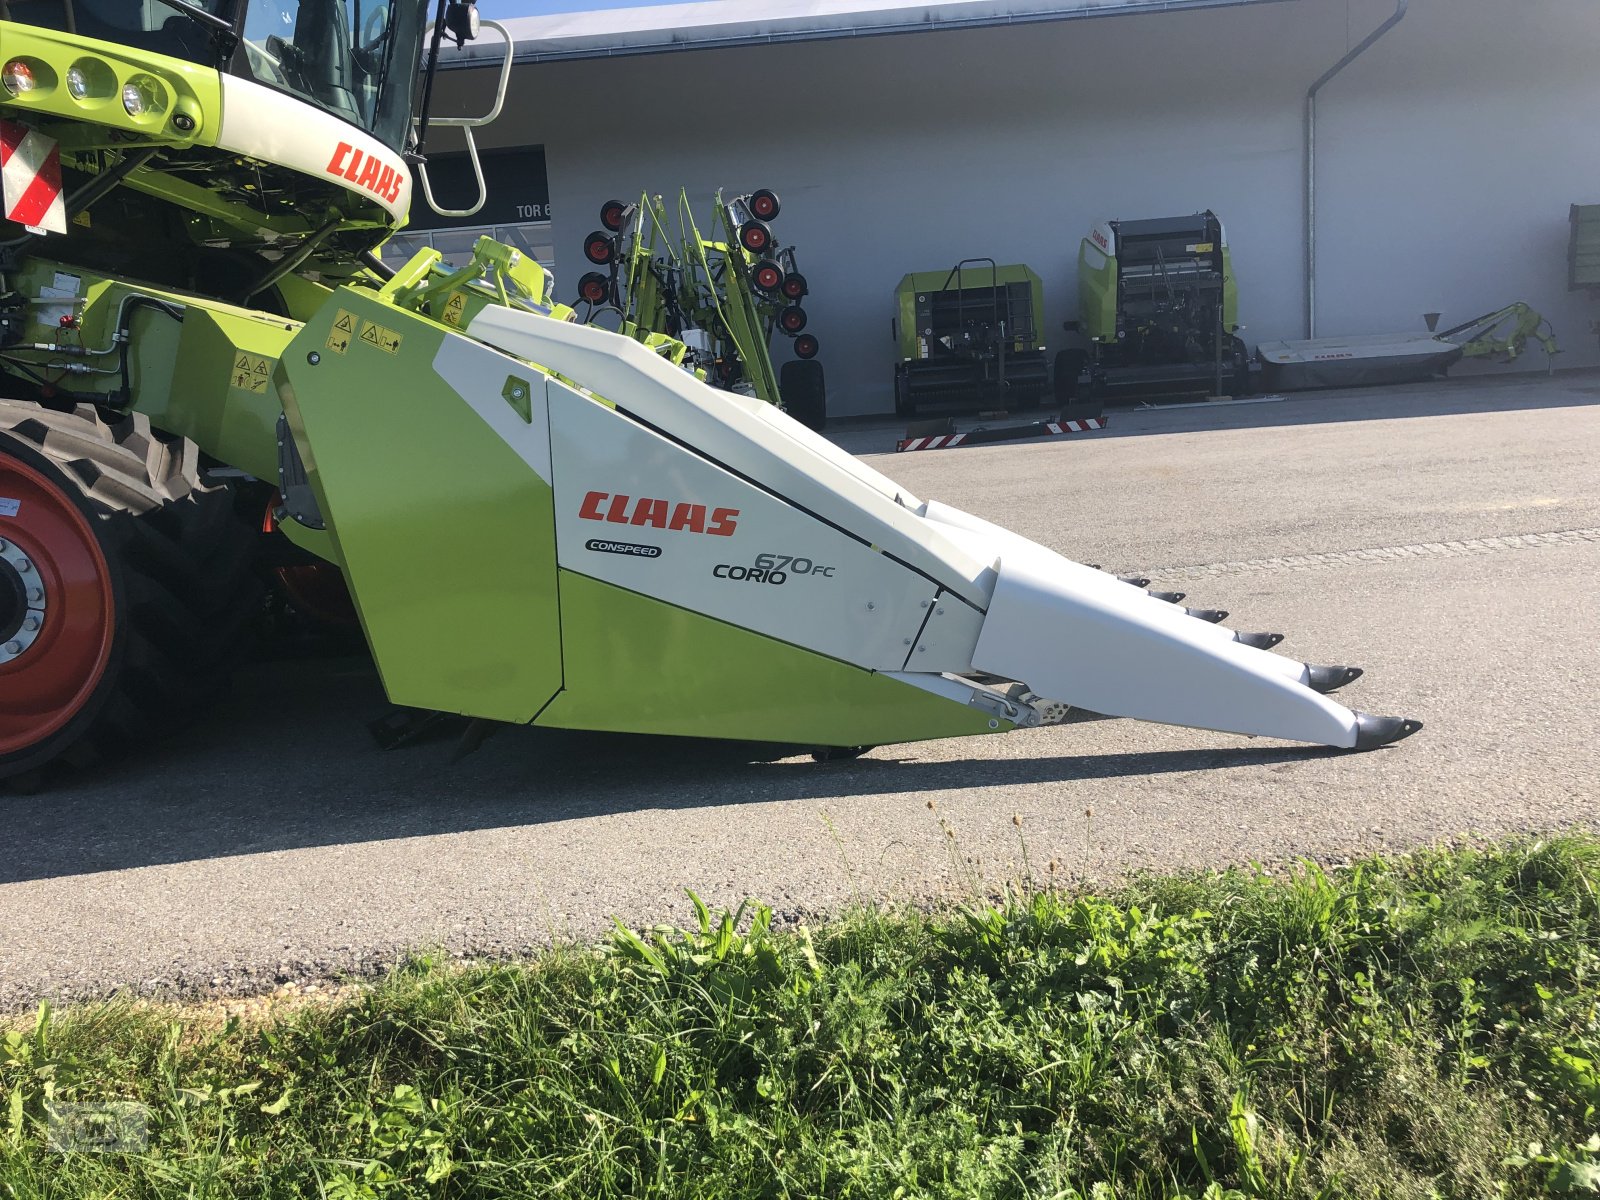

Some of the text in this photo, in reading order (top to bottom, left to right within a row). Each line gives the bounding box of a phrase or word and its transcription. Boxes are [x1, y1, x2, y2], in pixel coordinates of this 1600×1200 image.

[326, 141, 404, 204] CLAAS
[516, 204, 541, 218] TOR
[578, 491, 741, 537] CLAAS
[589, 541, 658, 556] CONSPEED
[712, 564, 788, 585] CORIO
